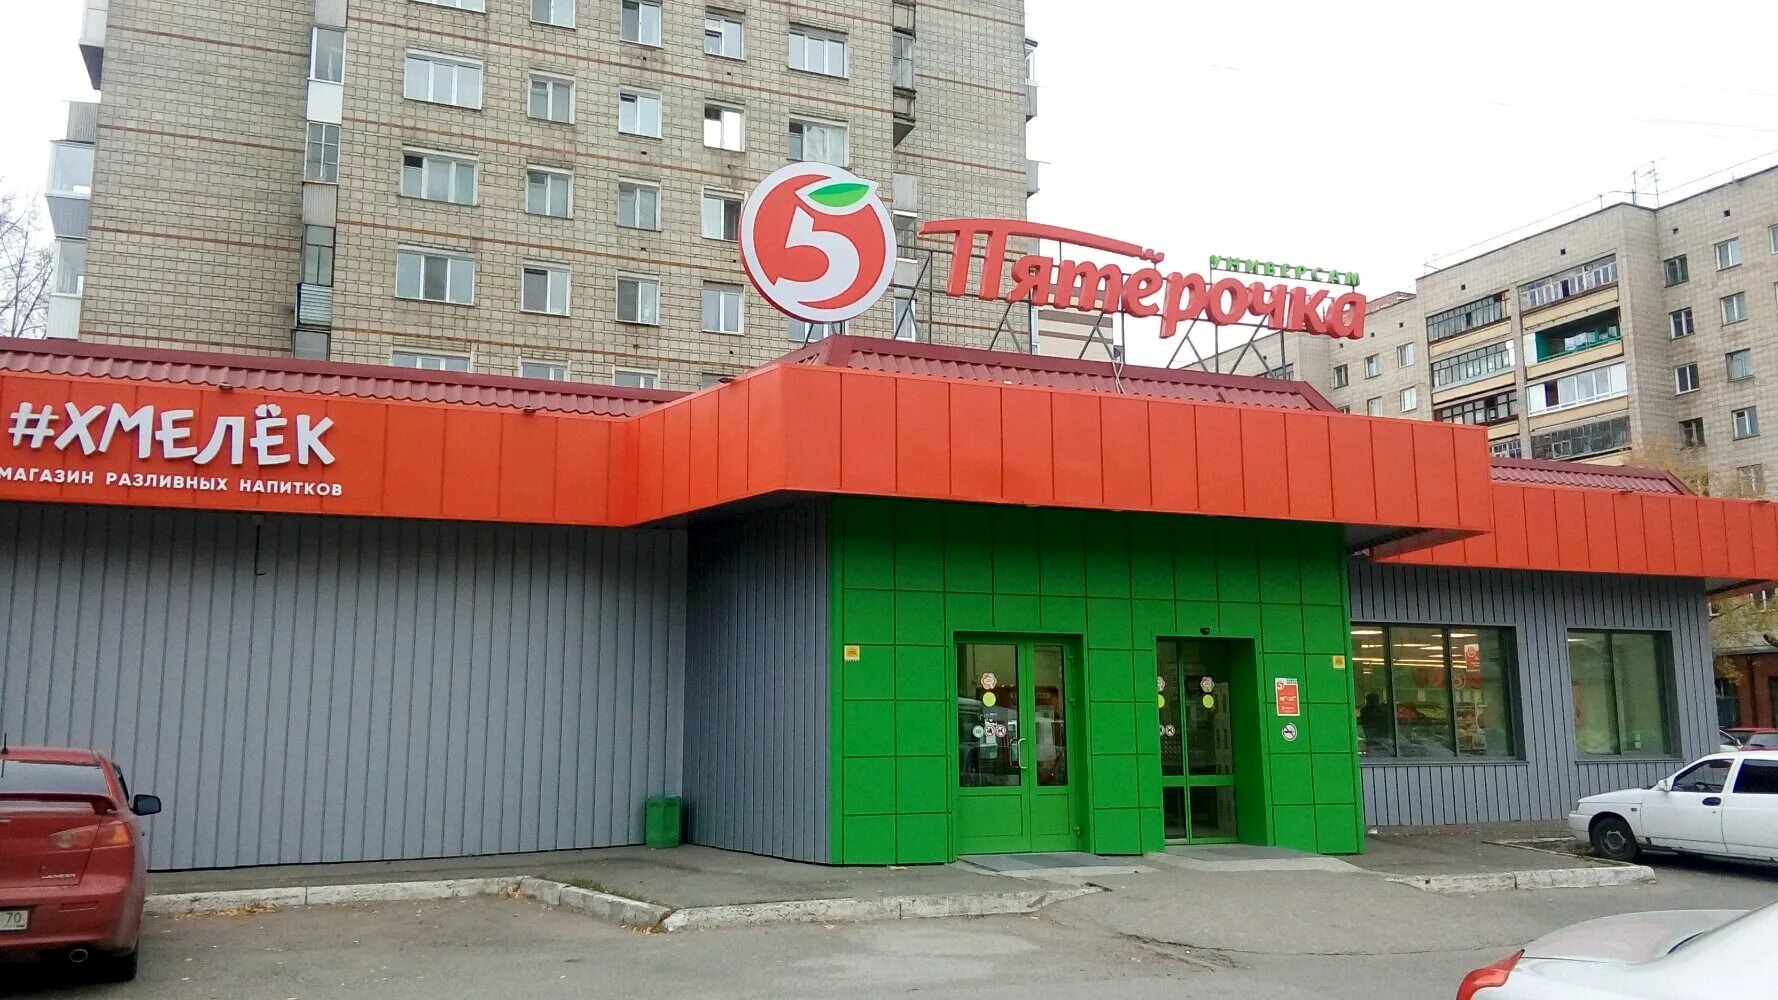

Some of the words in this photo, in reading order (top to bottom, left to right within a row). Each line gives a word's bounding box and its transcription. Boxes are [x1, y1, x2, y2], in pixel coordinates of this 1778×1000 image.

[770, 202, 862, 305] 5
[1209, 254, 1360, 287] УНИВЕРСАМ
[917, 218, 1367, 339] Пятёрочка
[8, 401, 336, 466] #ХМЕЛЁК
[0, 466, 94, 485] МАГАЗИН
[105, 472, 228, 491] РАЗЛИВНЫХ
[239, 478, 343, 497] НАПИТКОВ
[5, 912, 22, 923] 70
